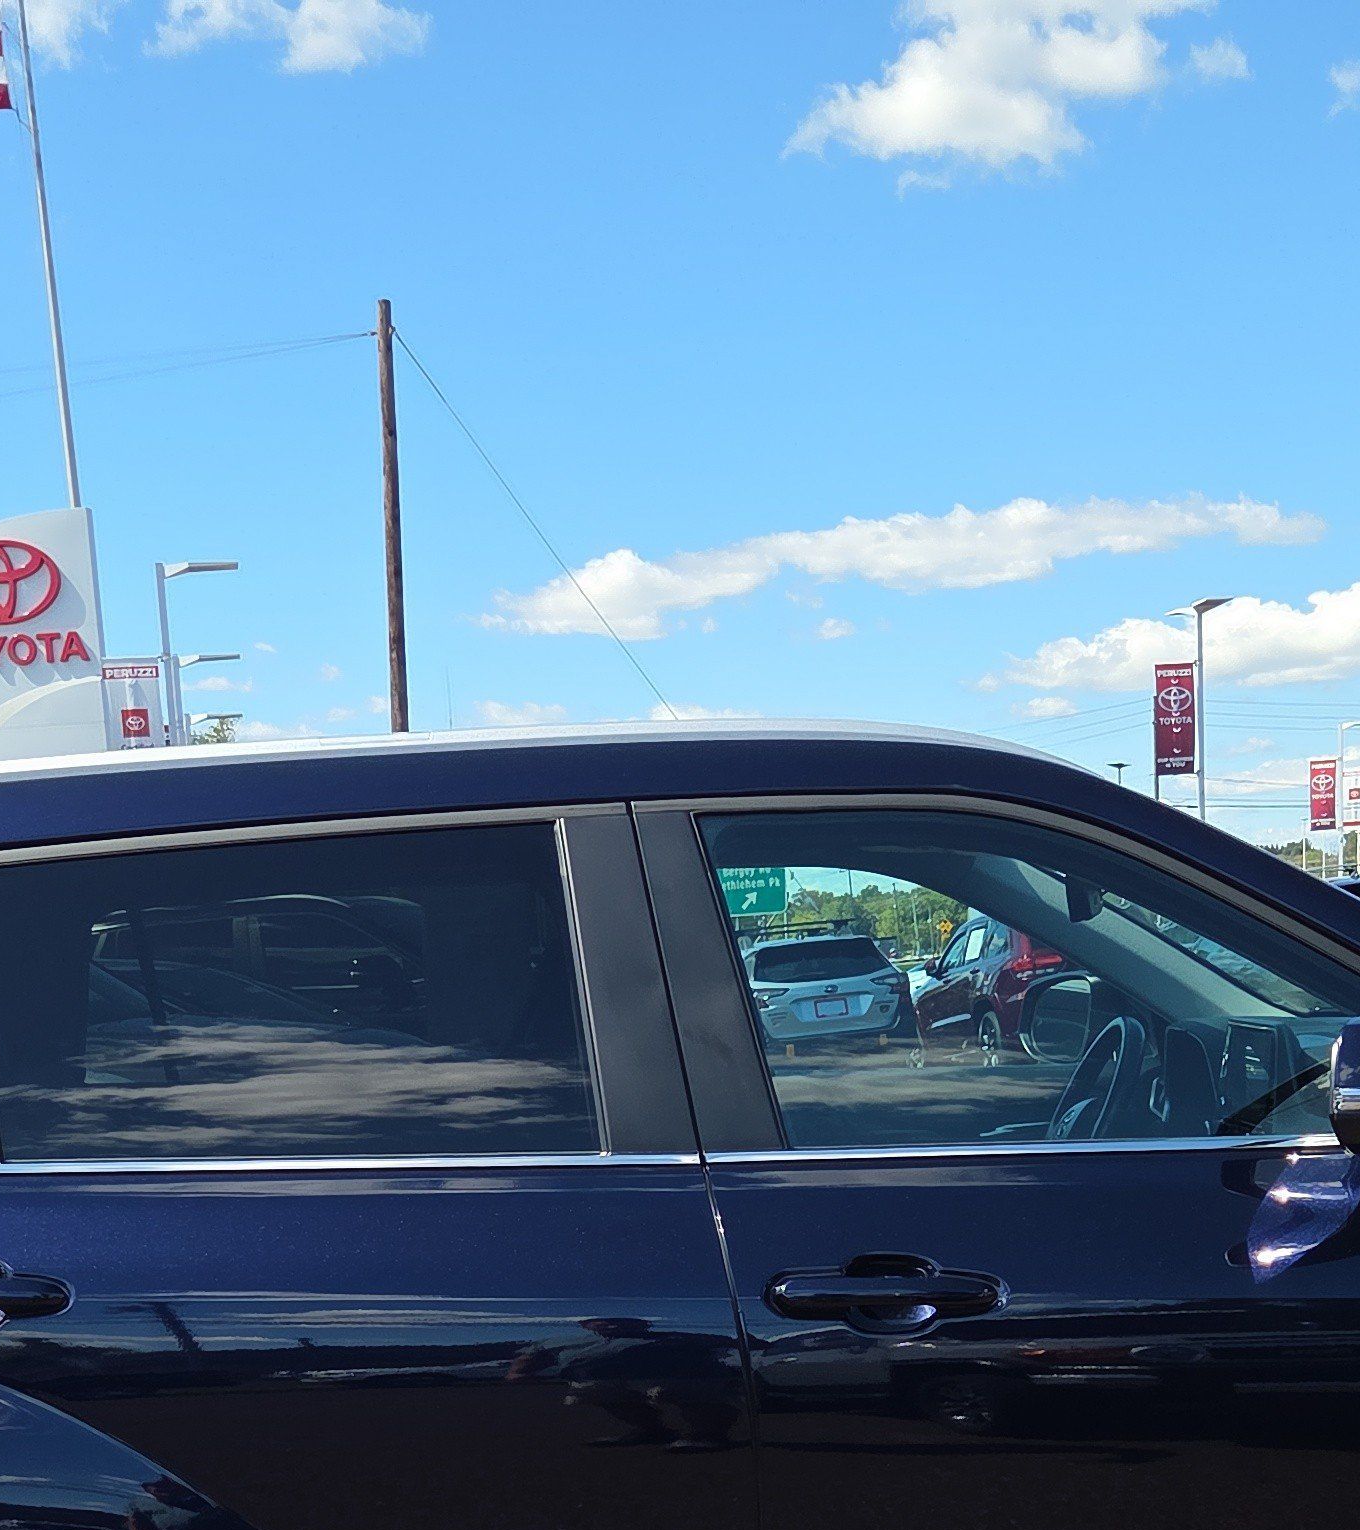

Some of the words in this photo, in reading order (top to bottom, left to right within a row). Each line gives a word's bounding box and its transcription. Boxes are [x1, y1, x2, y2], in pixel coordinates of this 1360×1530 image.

[105, 667, 157, 679] PERUZZI
[1158, 716, 1193, 726] TOYOTA
[721, 879, 766, 891] ethlehem
